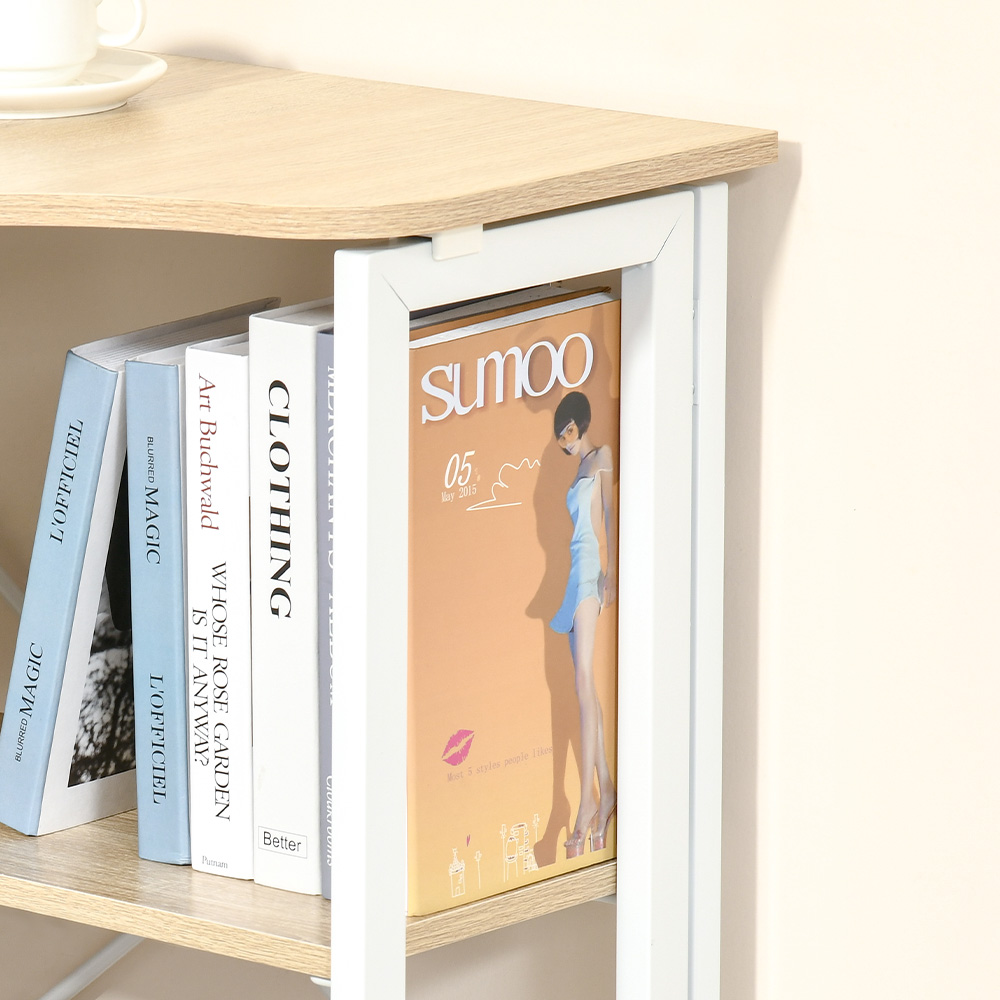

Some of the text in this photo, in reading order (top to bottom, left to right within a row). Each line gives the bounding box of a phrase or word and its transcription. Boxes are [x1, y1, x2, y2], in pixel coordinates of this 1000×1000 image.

[49, 419, 84, 545] L'OFFICIEL
[144, 436, 161, 565] BLURRED MAGIC
[198, 372, 220, 531] Art Buchwald
[268, 379, 292, 619] CLOTHING
[441, 483, 477, 503] May 2015
[444, 450, 476, 488] 05
[14, 642, 43, 762] BLURRED MAGIC
[150, 673, 168, 805] L'OFFICIEL
[192, 607, 210, 767] IS IT ANYWAY?
[211, 561, 231, 821] WHOSE ROSE GARDEN
[467, 766, 473, 776] 5
[476, 760, 501, 774] styles
[504, 752, 529, 767] people
[202, 855, 228, 869] Putnam
[263, 831, 302, 852] Better
